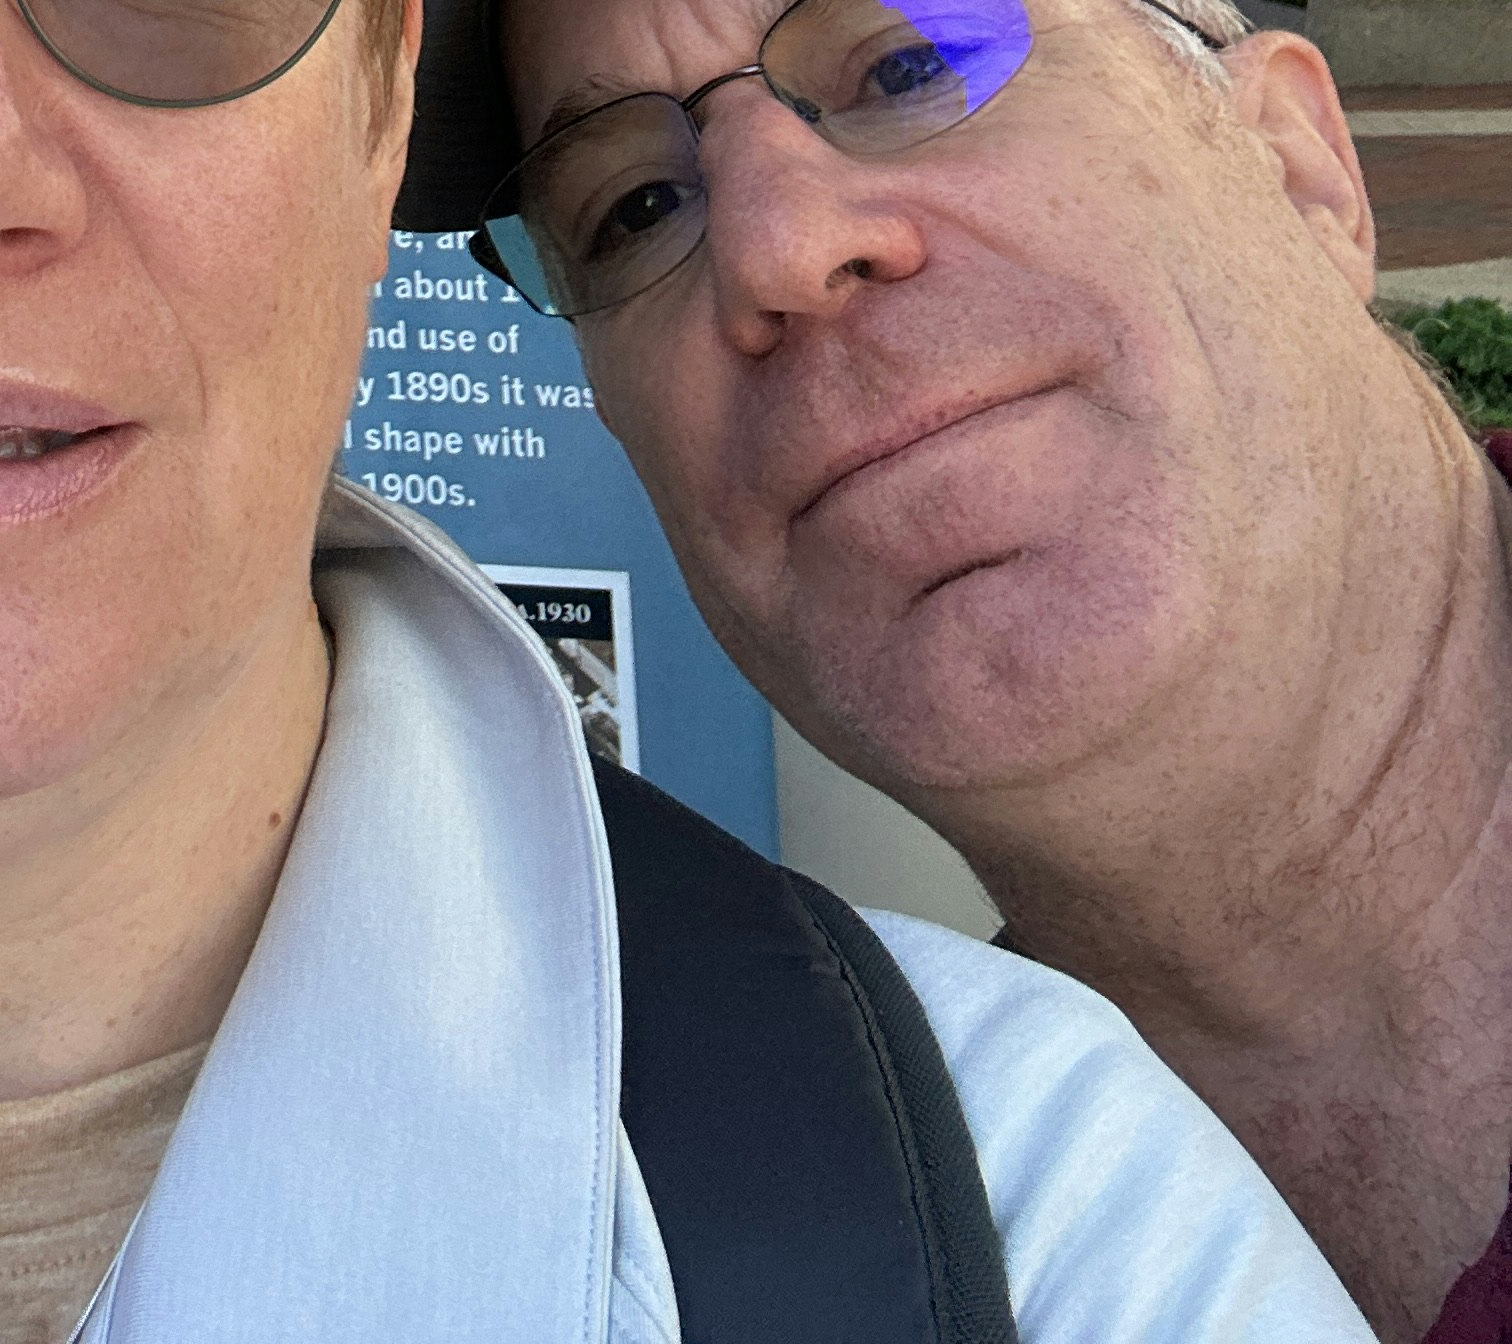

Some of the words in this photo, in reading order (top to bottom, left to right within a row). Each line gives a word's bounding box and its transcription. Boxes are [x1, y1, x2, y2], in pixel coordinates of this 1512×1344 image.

[394, 270, 489, 301] about
[418, 328, 477, 352] use
[487, 324, 521, 353] of
[387, 371, 490, 404] 1890s
[500, 375, 526, 406] it
[534, 383, 595, 408] was
[364, 422, 464, 461] shape
[473, 427, 546, 459] with
